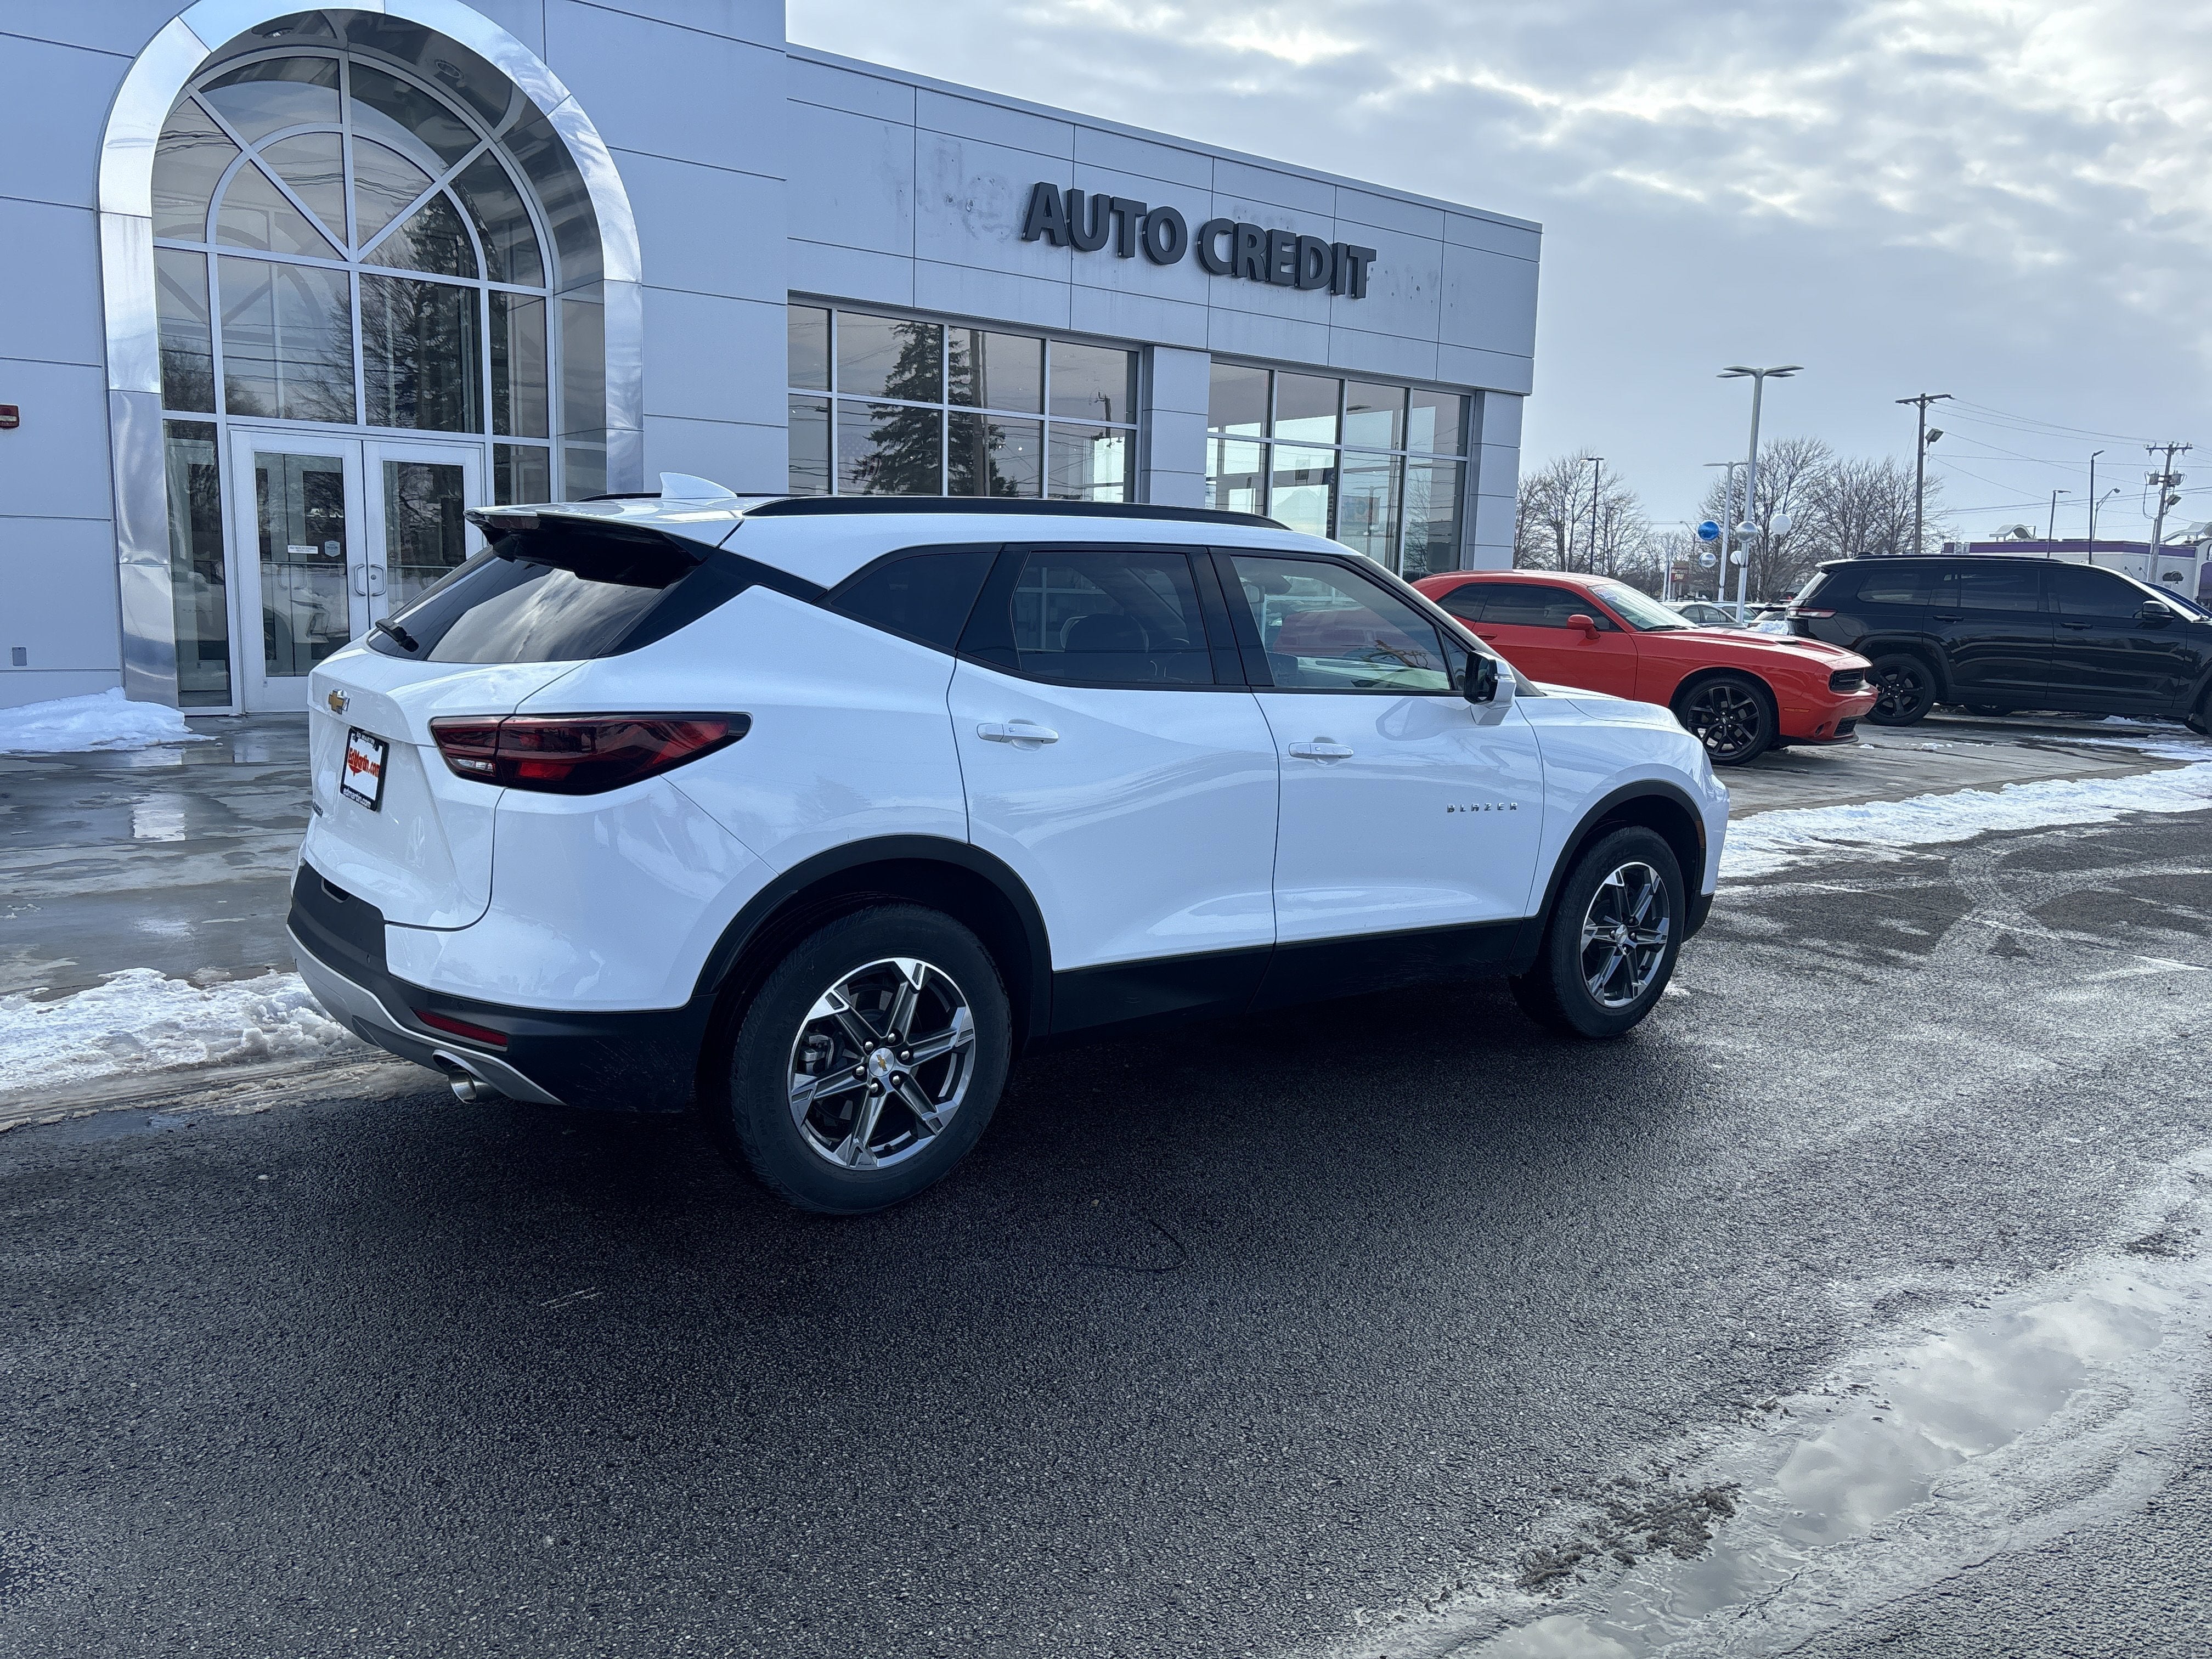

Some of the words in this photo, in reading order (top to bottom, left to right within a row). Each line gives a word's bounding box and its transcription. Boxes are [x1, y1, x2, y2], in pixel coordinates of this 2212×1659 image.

[1022, 182, 1187, 265] AUTO
[1197, 218, 1376, 298] CREDIT
[1447, 802, 1518, 813] BLAZER
